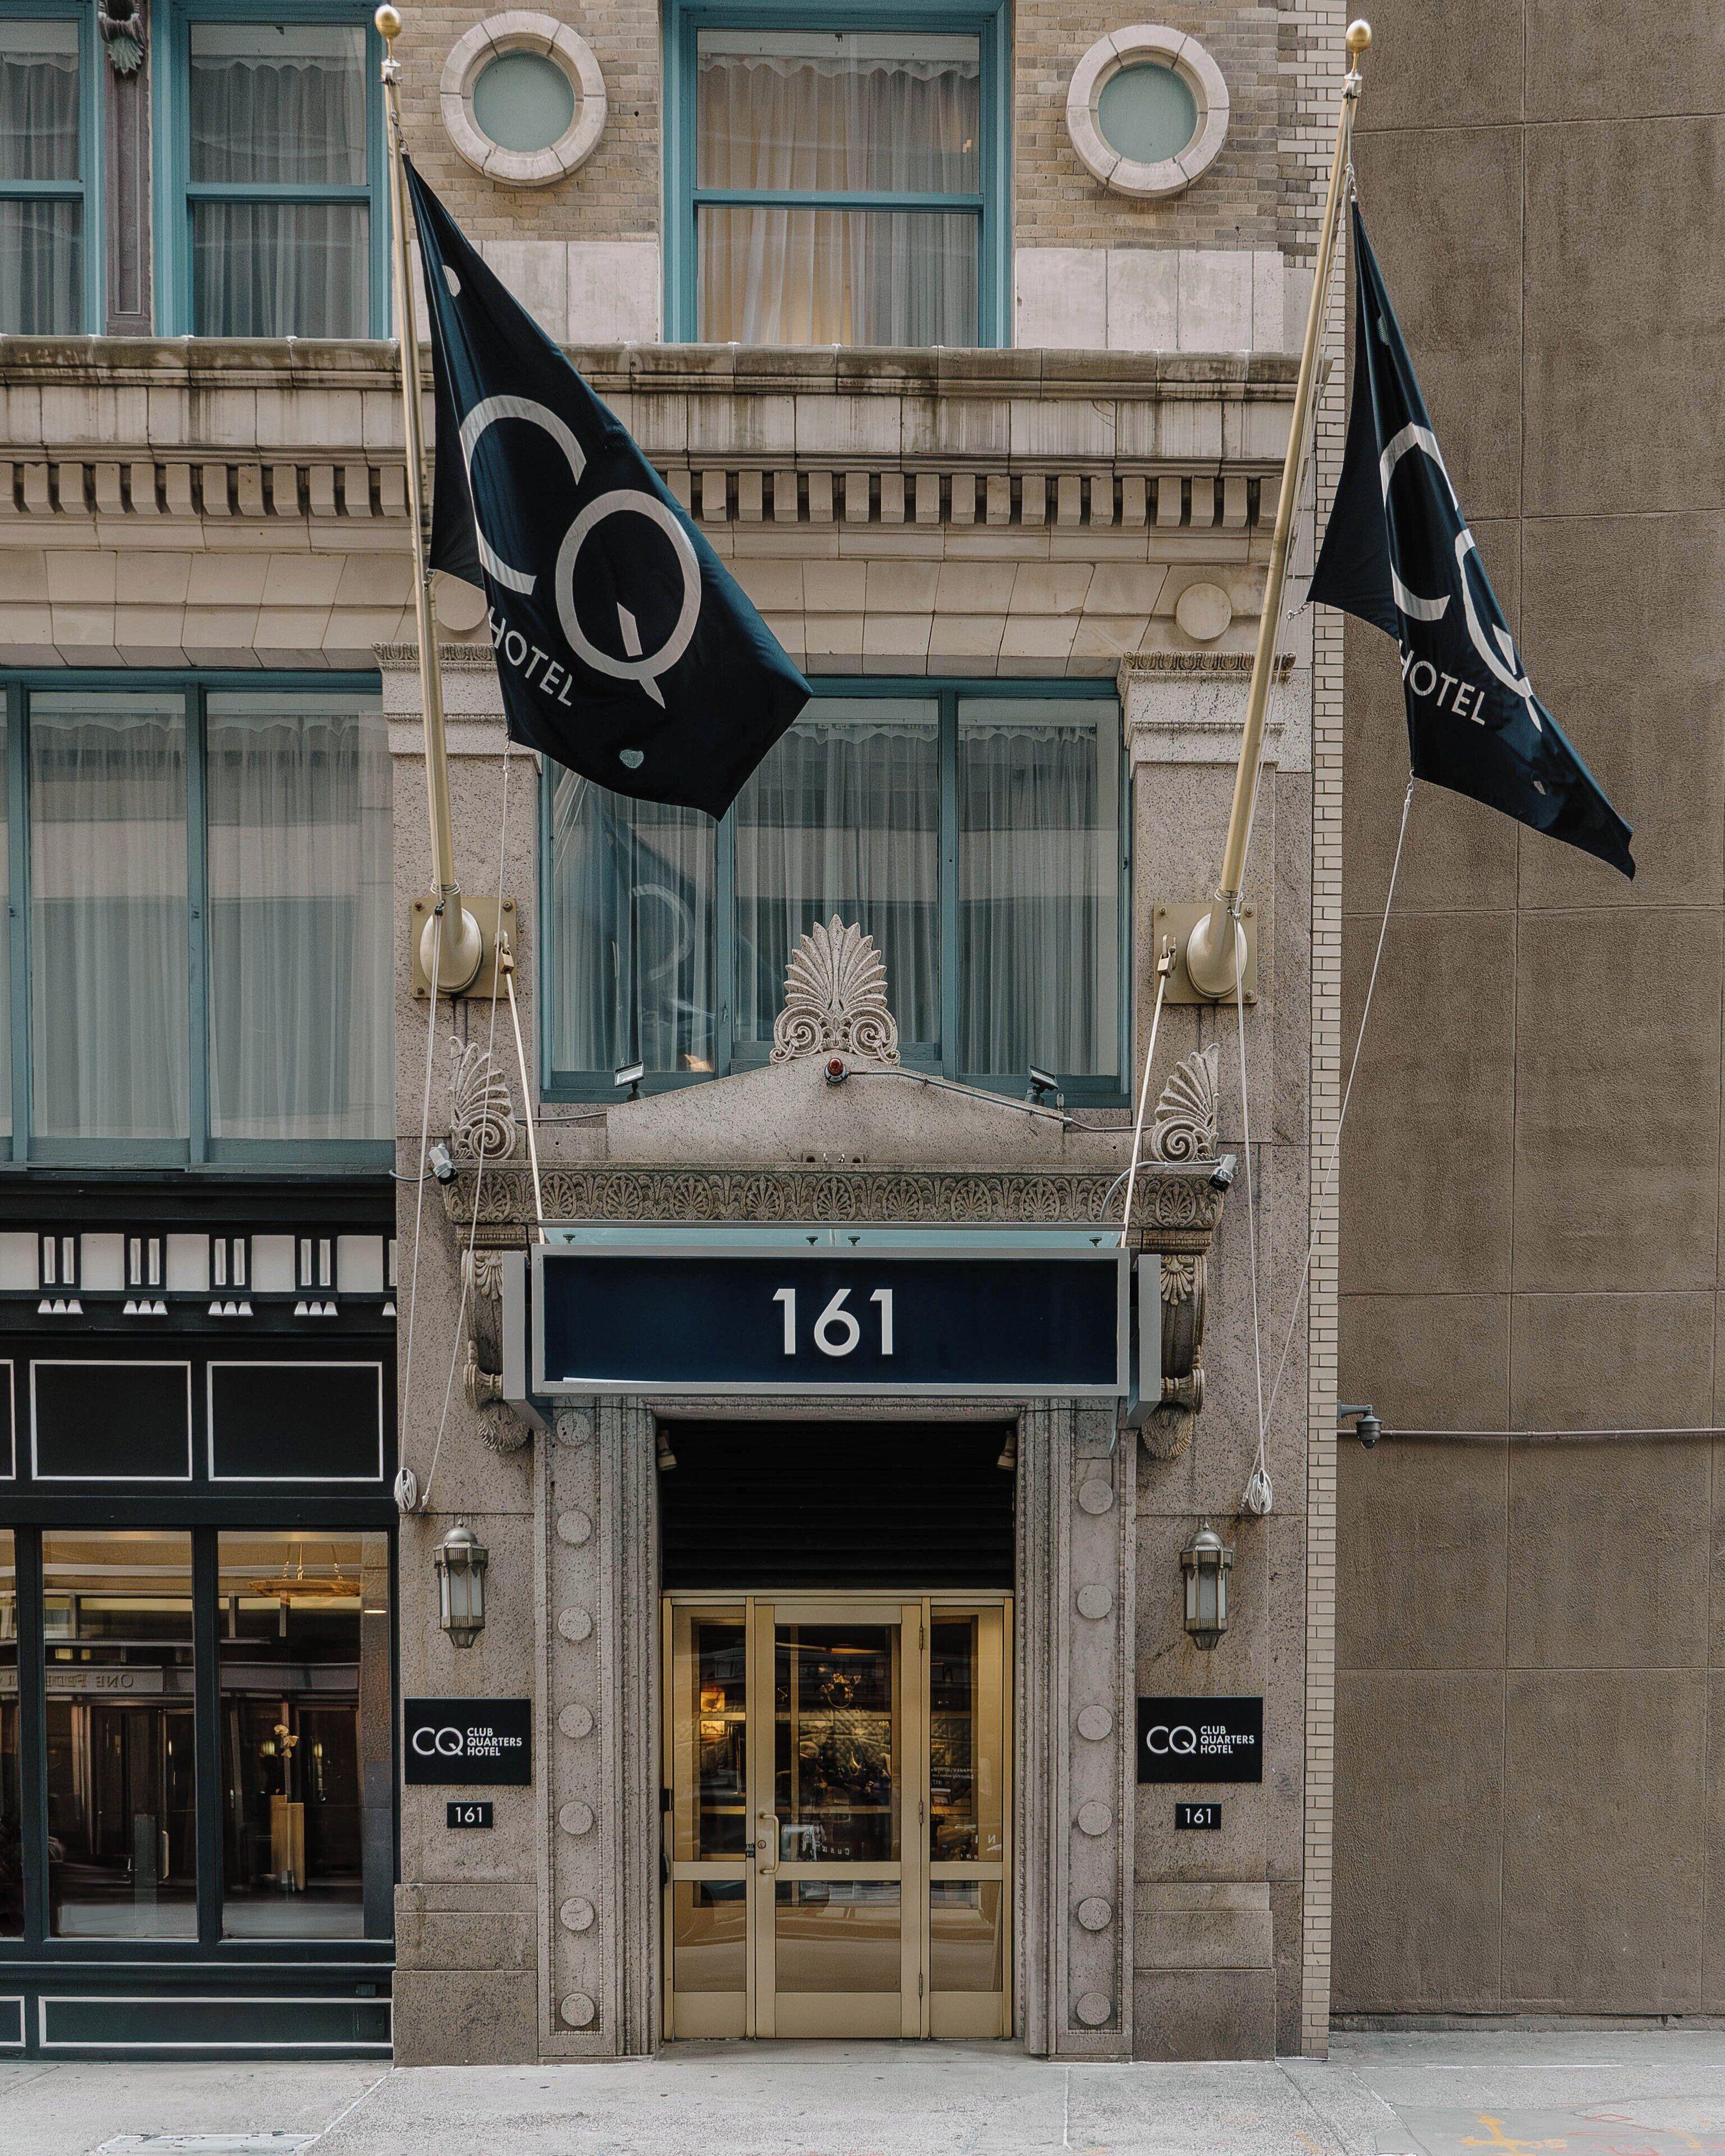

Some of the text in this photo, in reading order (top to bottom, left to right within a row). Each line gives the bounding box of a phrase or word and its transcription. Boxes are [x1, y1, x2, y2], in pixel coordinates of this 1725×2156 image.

[460, 395, 701, 709] CQ
[488, 606, 573, 706] HOTEL
[773, 1289, 893, 1356] 161
[467, 1728, 493, 1736] CLUB
[1201, 1726, 1226, 1734] CLUB
[412, 1727, 463, 1755] CQ
[467, 1737, 522, 1746] QUARTERS
[1146, 1726, 1197, 1753] CQ
[1201, 1735, 1254, 1744] QUARTERS
[467, 1747, 500, 1756] HOTEL
[1201, 1745, 1233, 1753] HOTEL
[455, 1807, 482, 1822] 161
[1185, 1808, 1211, 1823] 161
